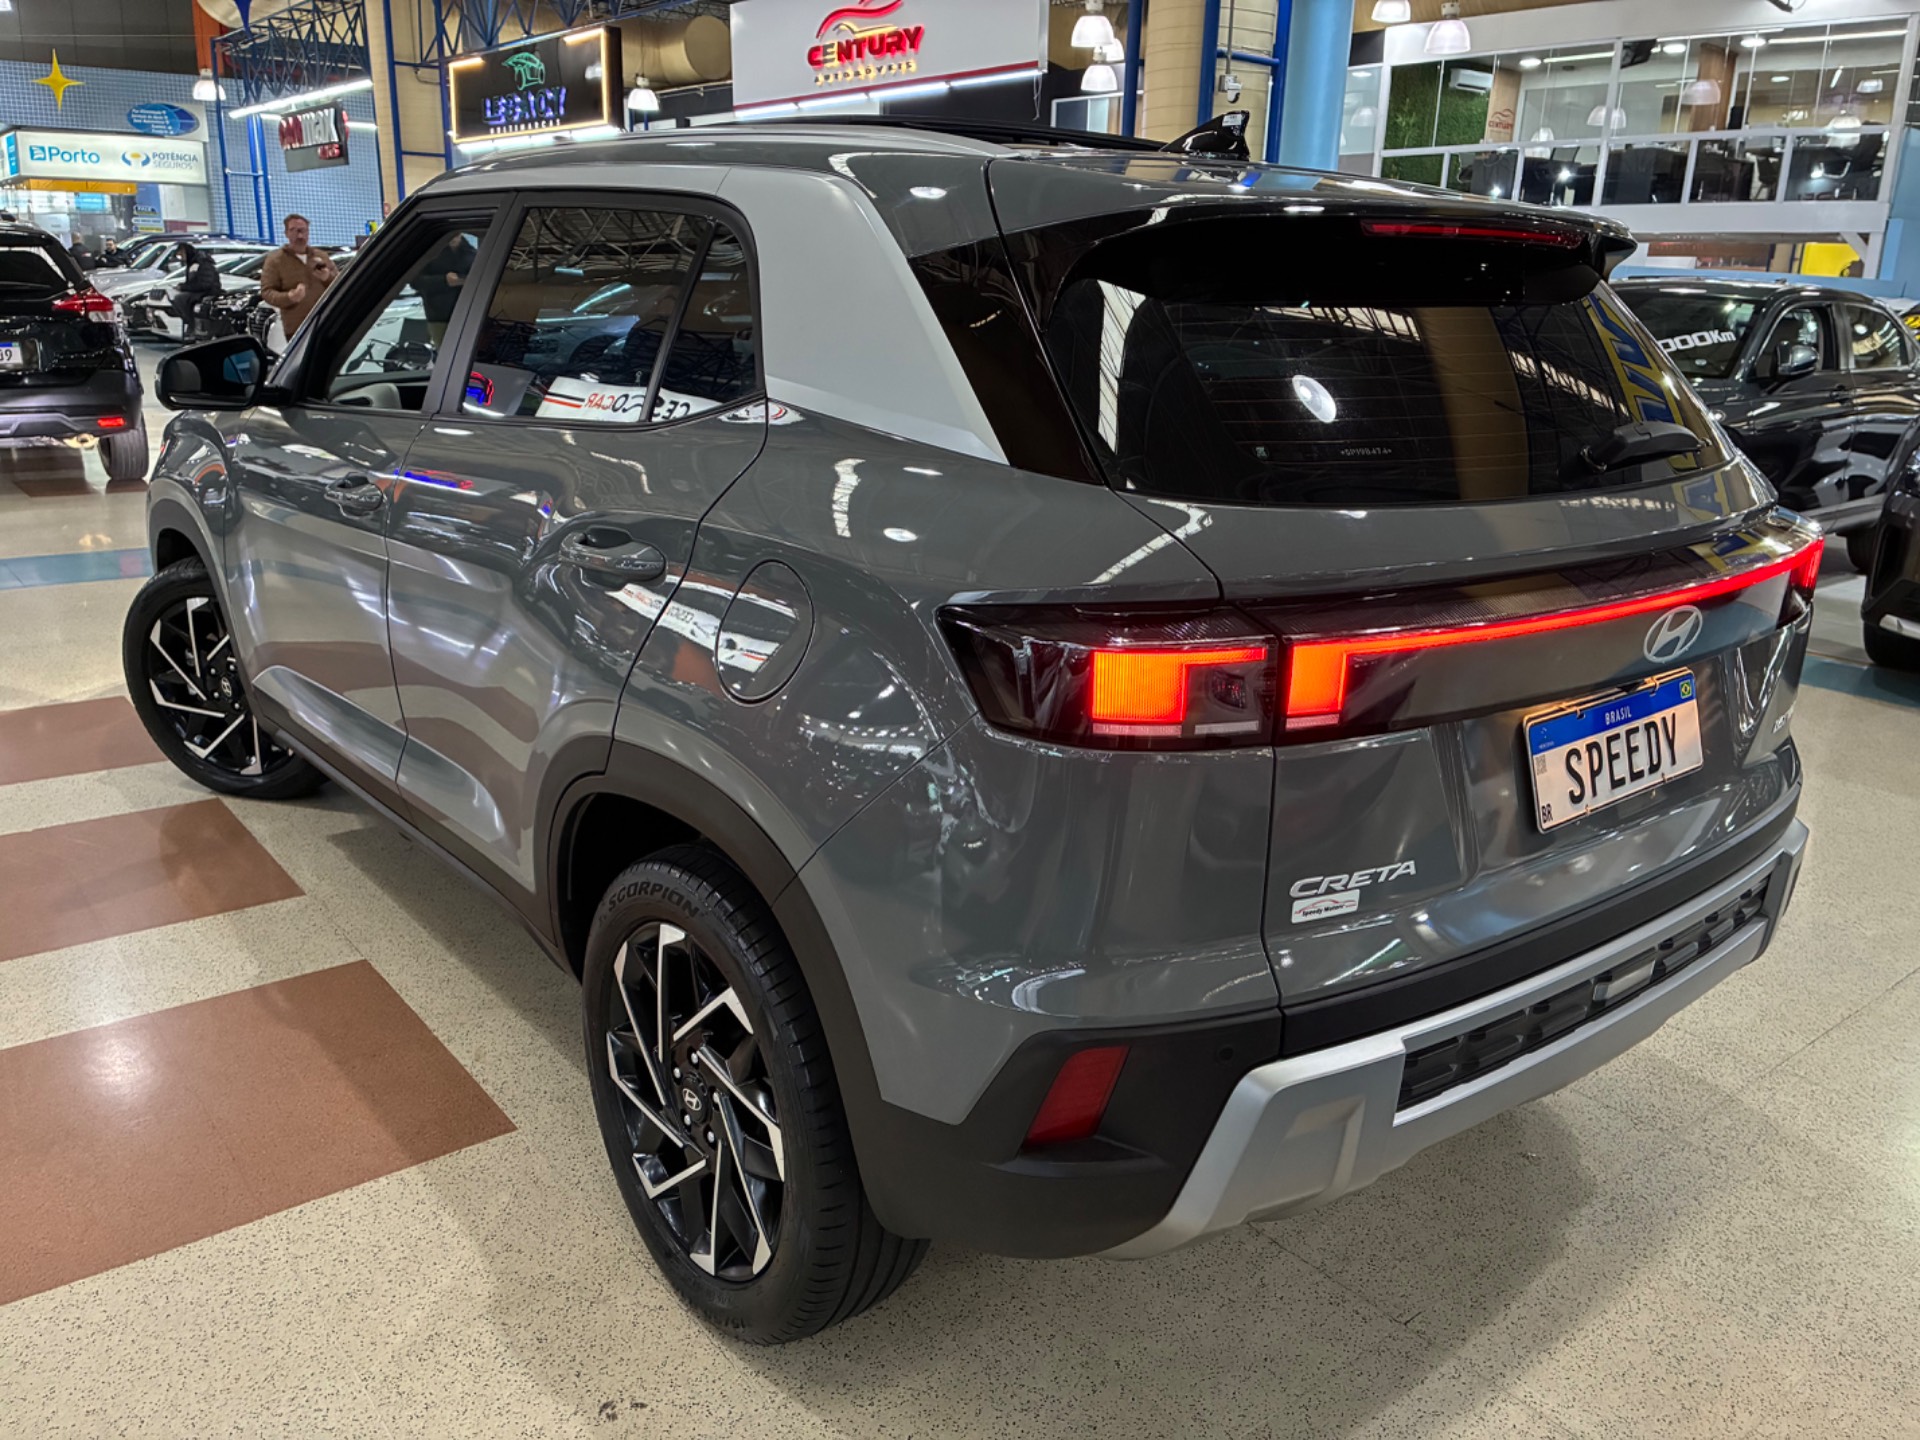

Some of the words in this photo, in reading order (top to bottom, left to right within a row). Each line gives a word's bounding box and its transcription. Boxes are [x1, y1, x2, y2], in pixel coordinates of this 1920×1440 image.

[808, 26, 925, 66] CENTURY
[483, 87, 566, 125] LEGACY
[48, 145, 101, 164] Porto
[152, 152, 198, 163] POTÊNCIA
[1605, 705, 1632, 725] BRASIL
[1565, 712, 1678, 805] SPEEDY
[1541, 803, 1554, 824] BR
[1289, 860, 1417, 898] CRETA
[608, 881, 700, 918] SCORPION
